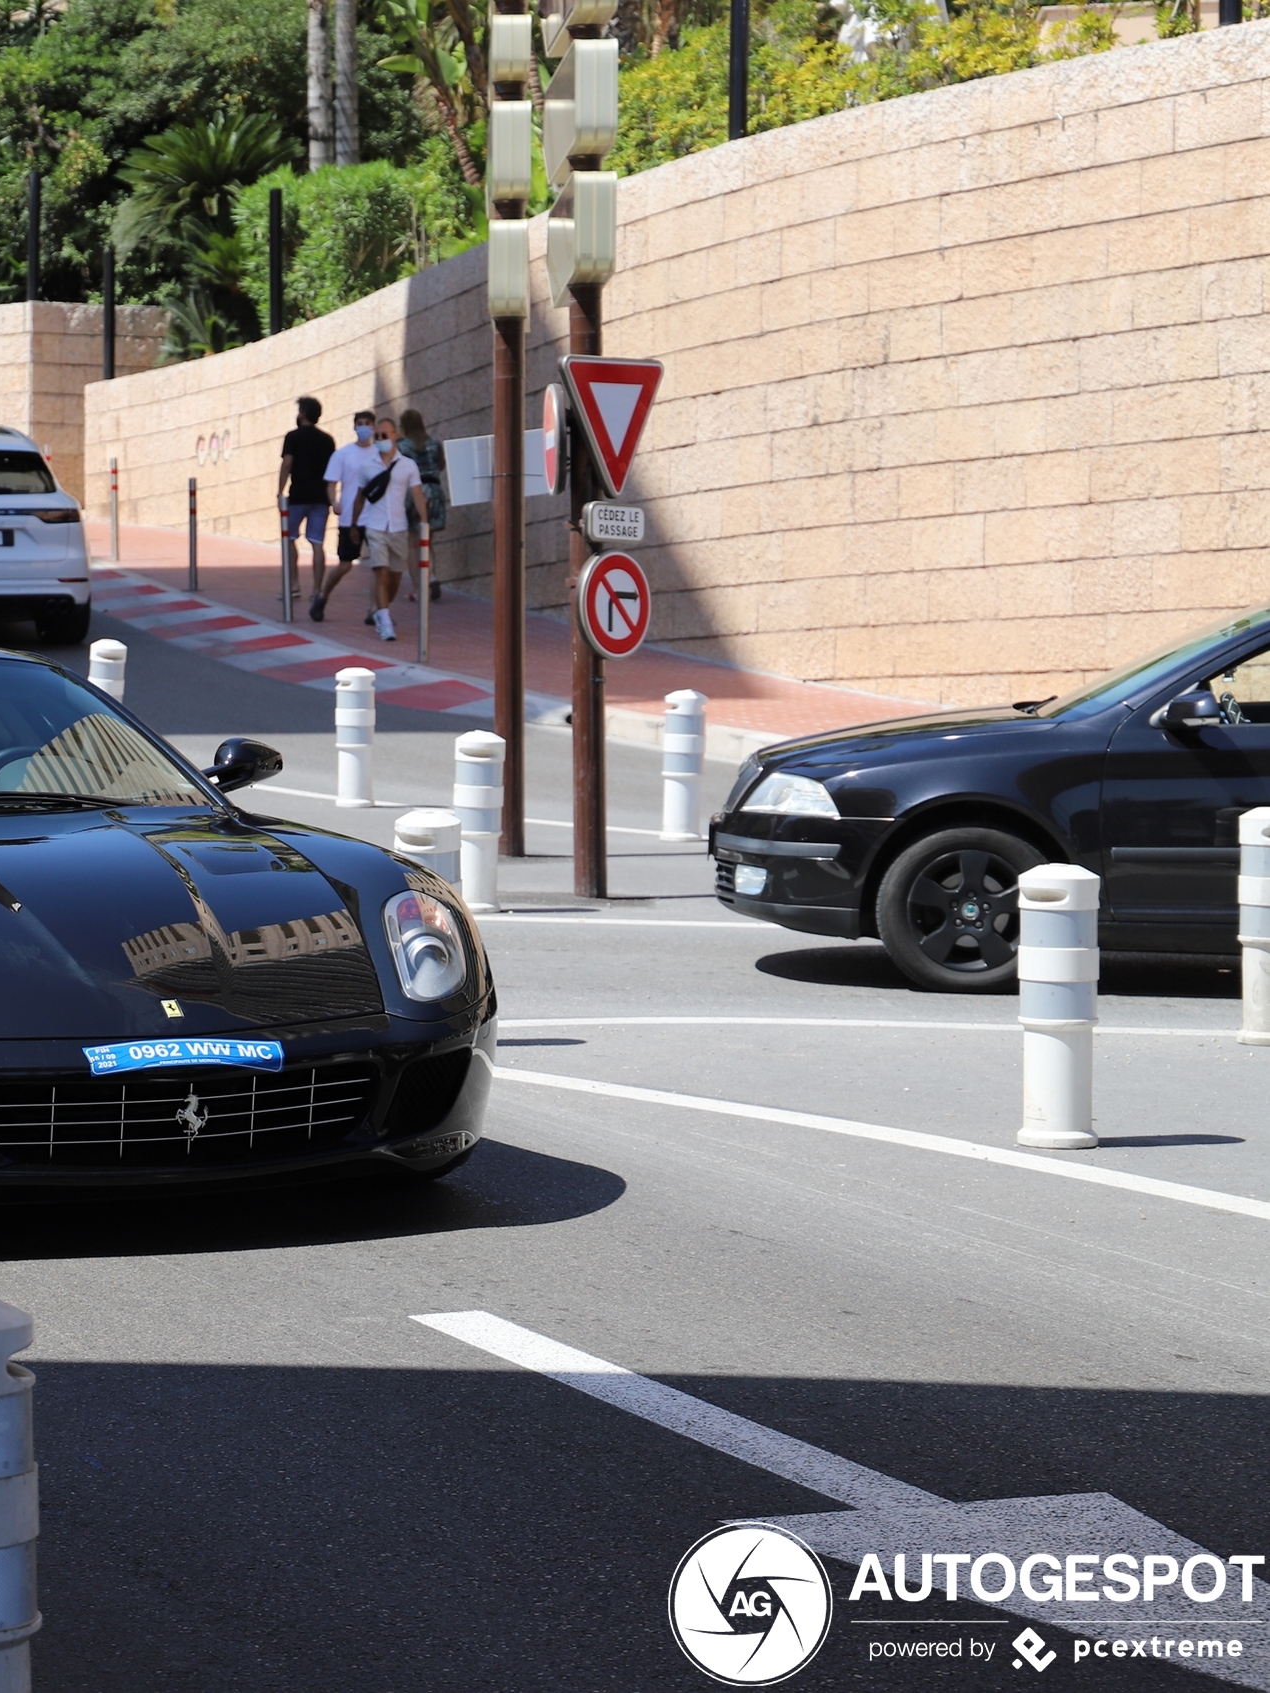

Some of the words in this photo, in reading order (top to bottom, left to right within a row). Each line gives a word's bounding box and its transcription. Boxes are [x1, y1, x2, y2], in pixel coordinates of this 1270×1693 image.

[598, 506, 626, 522] CÉDEZ
[629, 511, 640, 523] LE
[599, 524, 639, 538] PASSAGE
[128, 1043, 183, 1060] 0962
[185, 1041, 230, 1056] WW
[237, 1043, 273, 1060] MC
[97, 1060, 118, 1069] 2021
